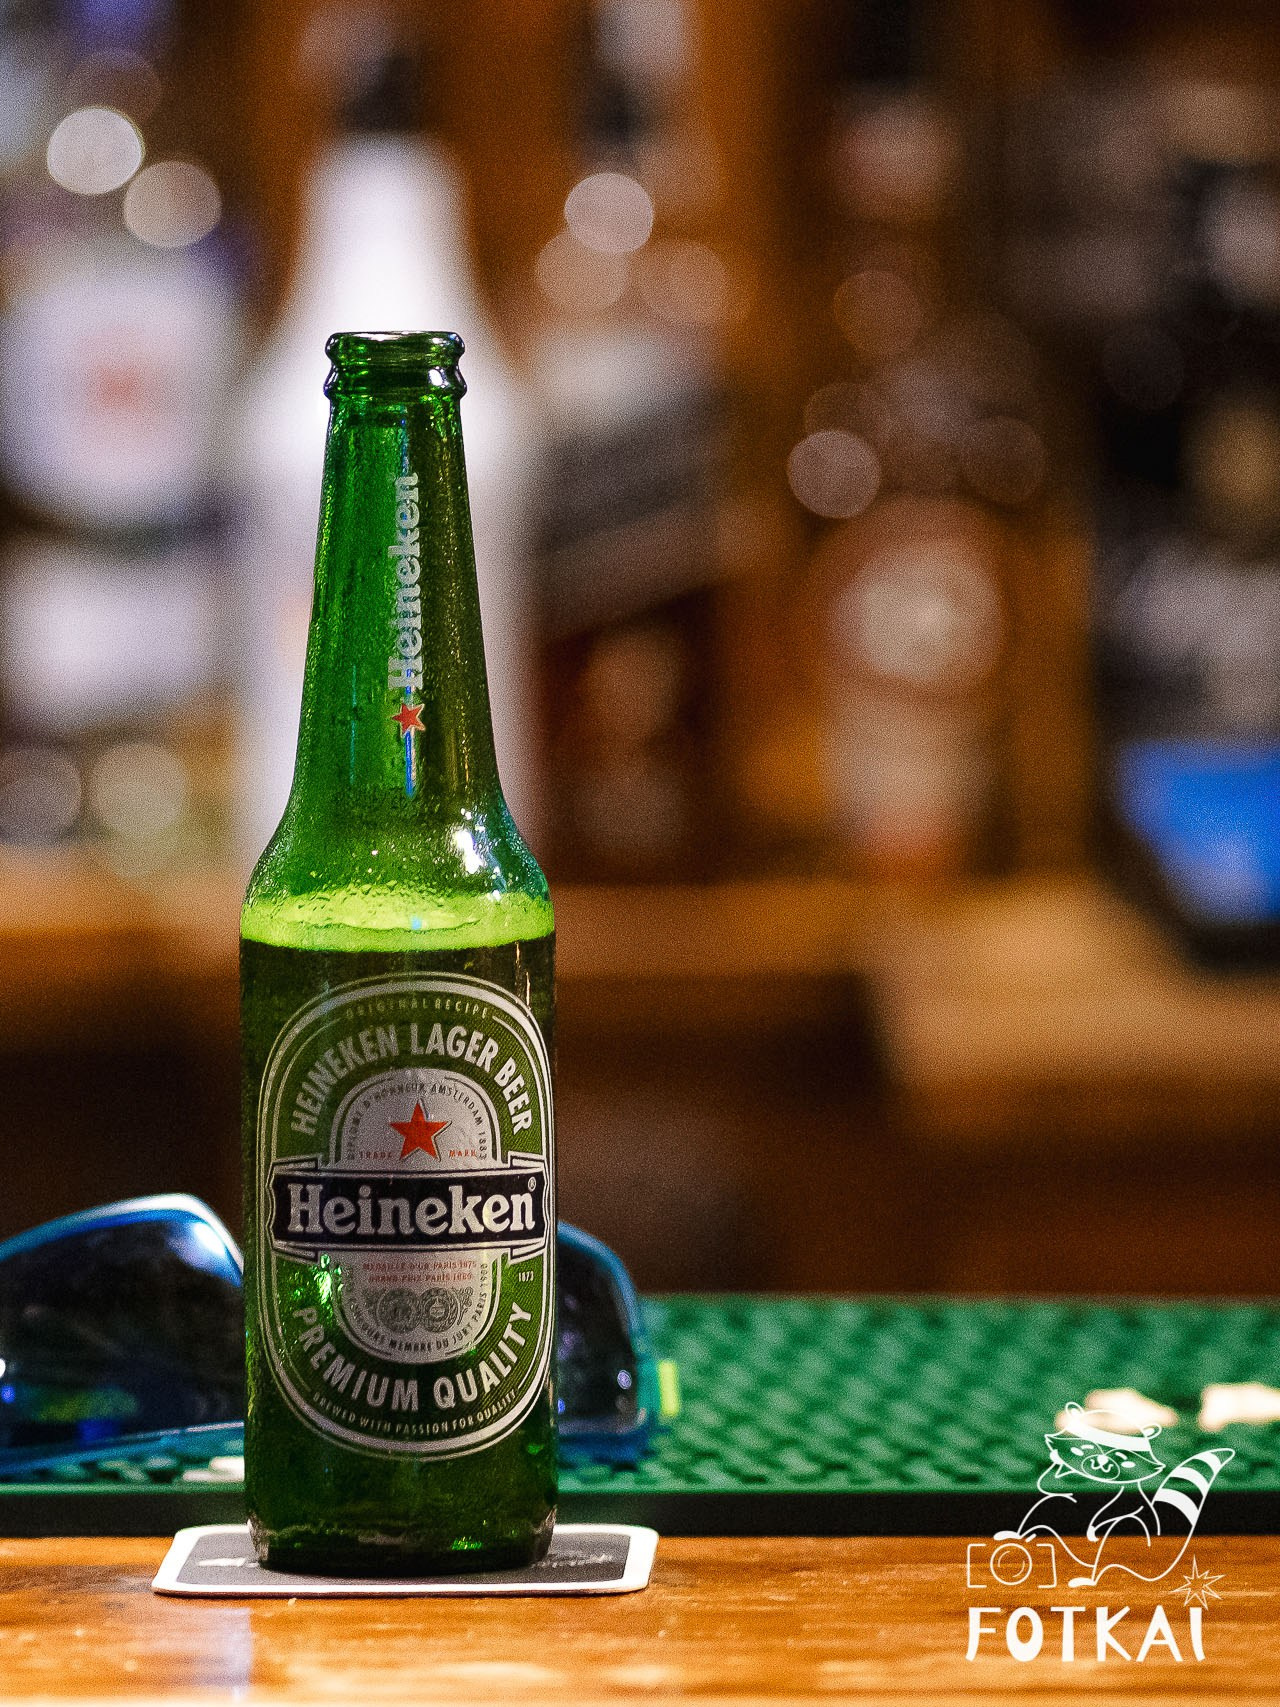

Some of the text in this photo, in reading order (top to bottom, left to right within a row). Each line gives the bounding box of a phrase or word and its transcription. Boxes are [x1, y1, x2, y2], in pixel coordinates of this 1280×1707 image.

[388, 472, 423, 690] Heineken
[434, 998, 488, 1019] RECIPE
[290, 1022, 533, 1136] HEINEKEN LAGER BEER
[431, 1083, 484, 1127] AMSTERDAM
[448, 1149, 478, 1159] MARK
[287, 1183, 536, 1235] Heineken
[293, 1301, 533, 1412] PREMIUM QUALITY
[436, 1338, 449, 1351] DU
[452, 1322, 474, 1344] JURY
[312, 1388, 517, 1435] BREWED WITH PASSION FOR QUALITY
